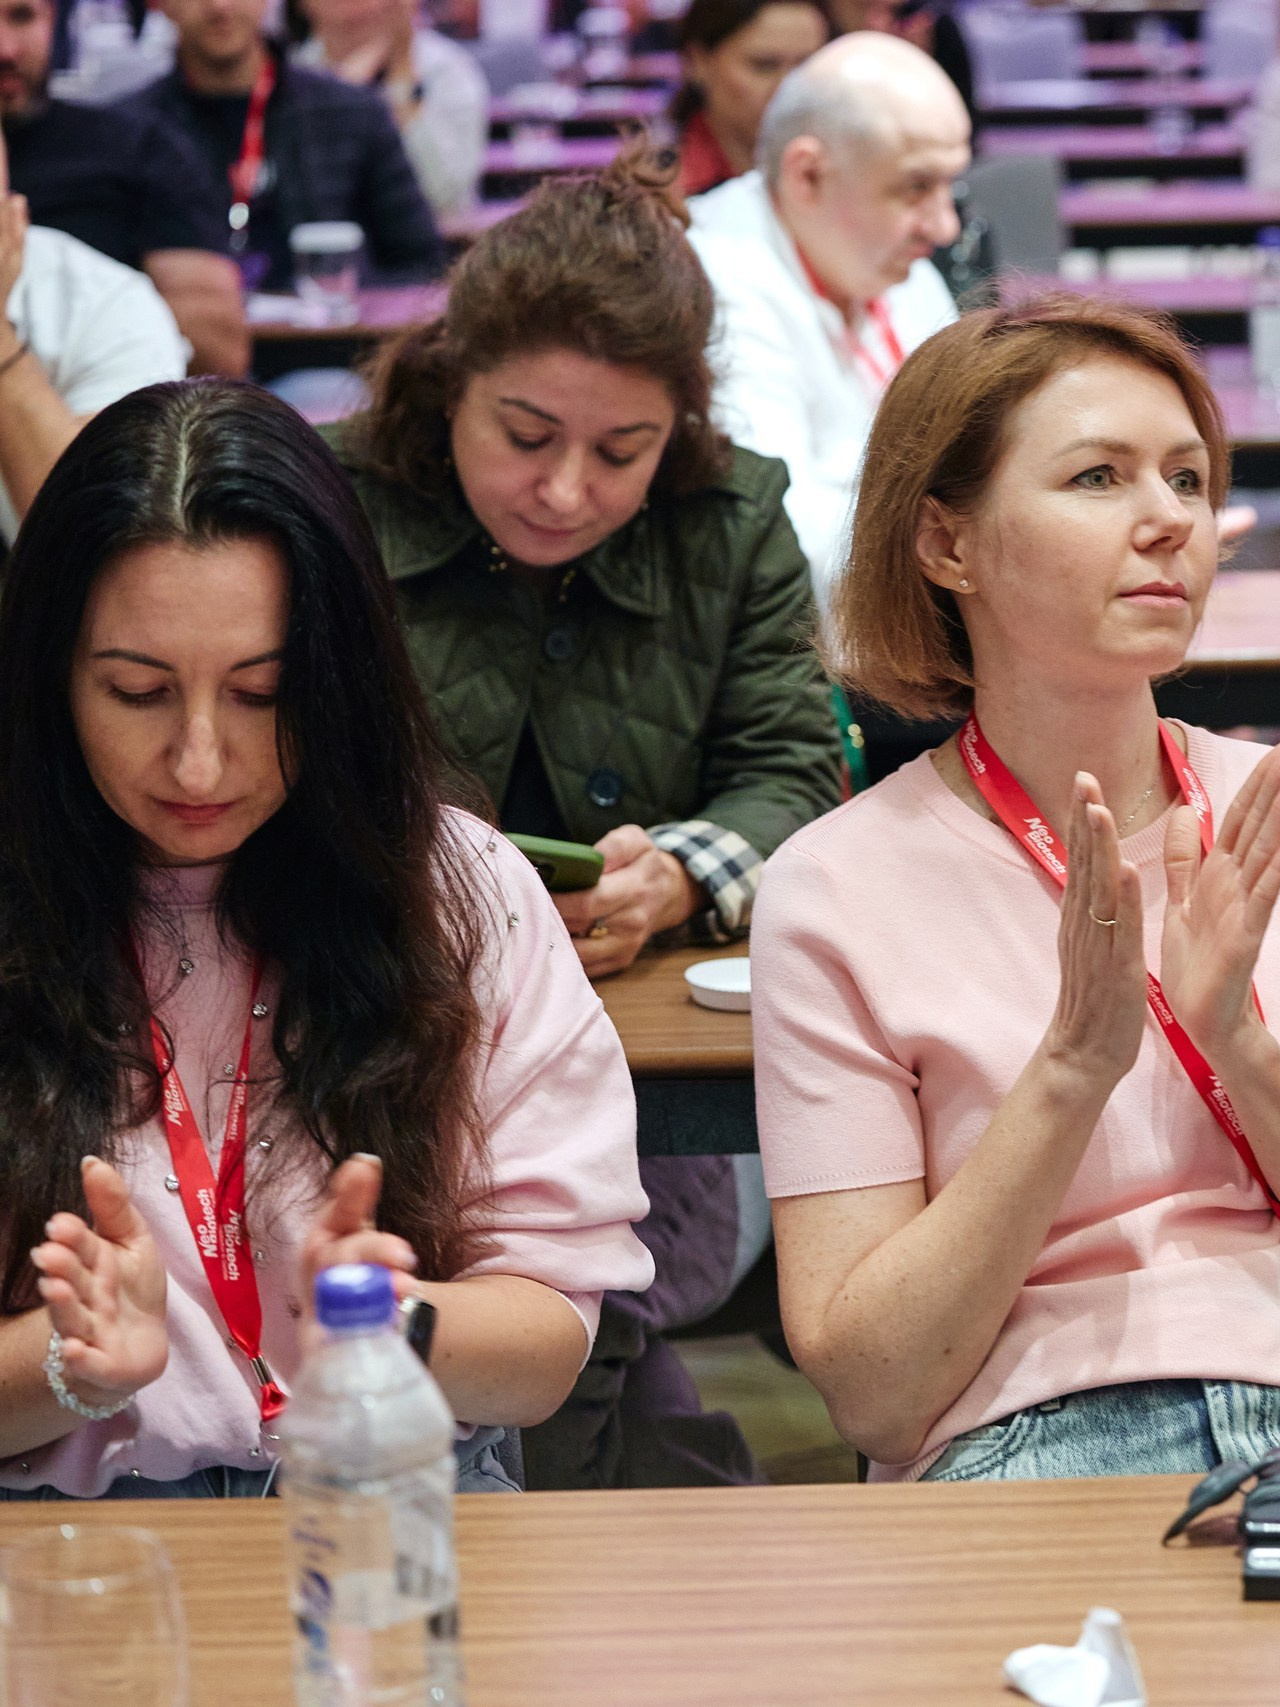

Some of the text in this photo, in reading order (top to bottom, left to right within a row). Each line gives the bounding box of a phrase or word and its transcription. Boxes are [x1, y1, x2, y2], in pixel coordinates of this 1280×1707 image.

[1023, 817, 1055, 844] Neo
[1027, 830, 1067, 873] Biotech
[196, 1189, 217, 1244] Biotech
[196, 1224, 219, 1258] Neo
[223, 1224, 240, 1281] Biotech
